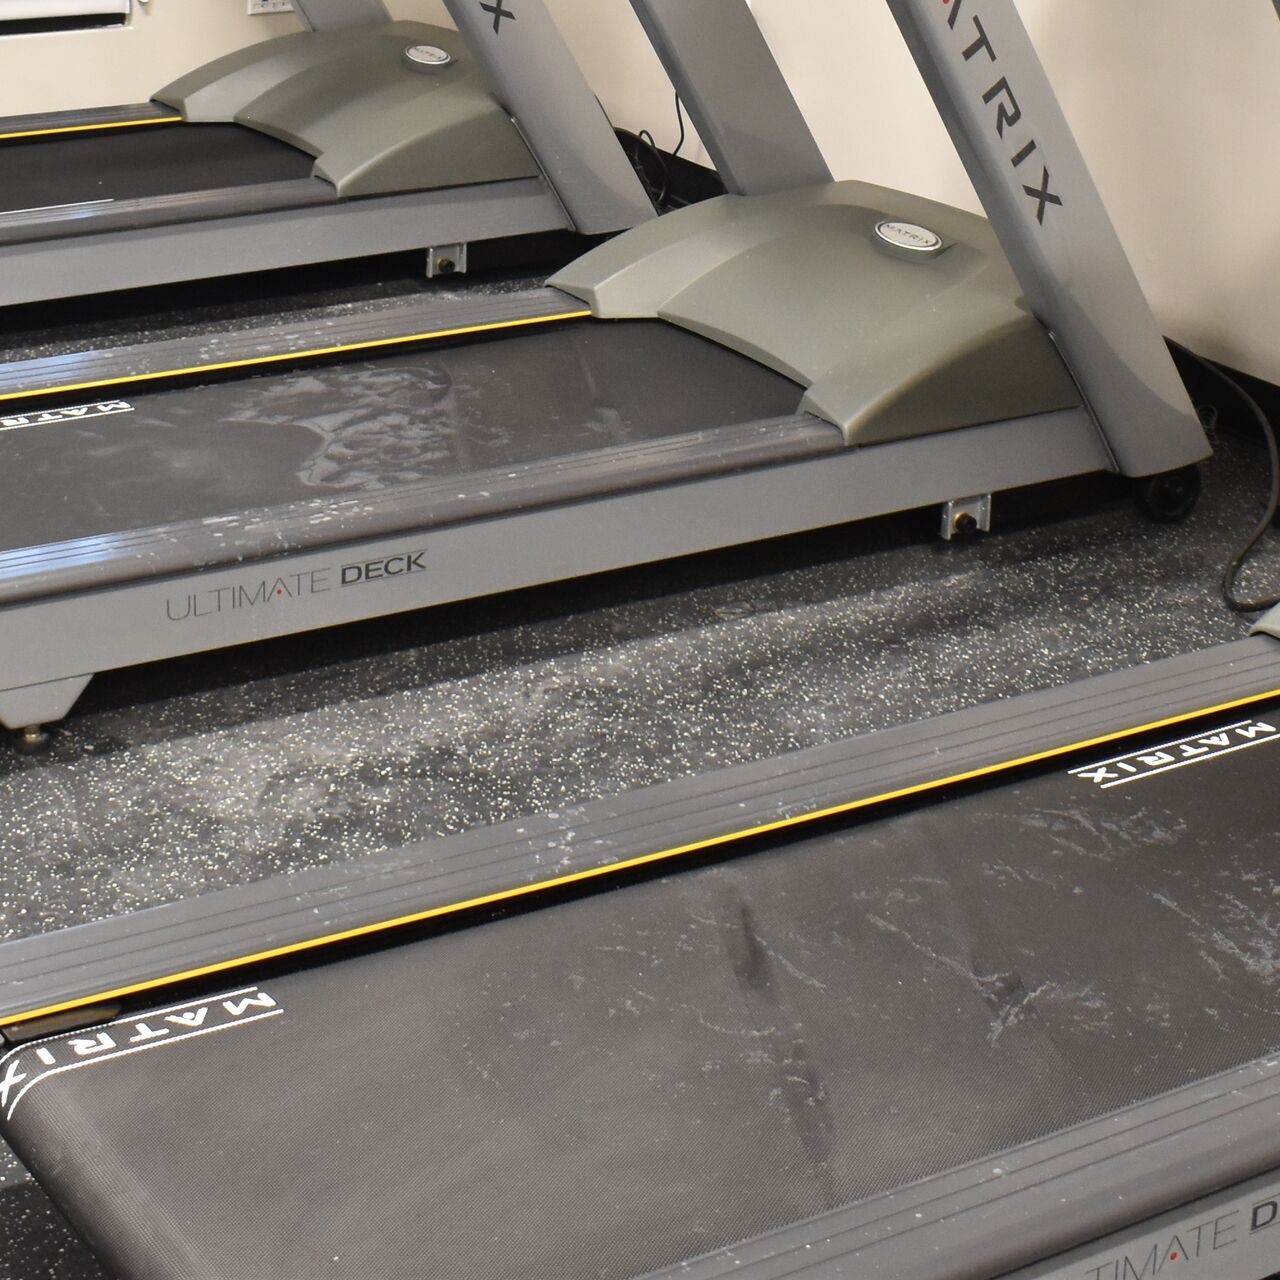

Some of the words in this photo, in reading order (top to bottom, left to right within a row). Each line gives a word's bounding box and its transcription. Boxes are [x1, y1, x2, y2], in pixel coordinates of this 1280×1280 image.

[166, 568, 331, 621] ULTIMATE
[341, 551, 426, 585] DECK
[1077, 721, 1277, 783] MATRIX
